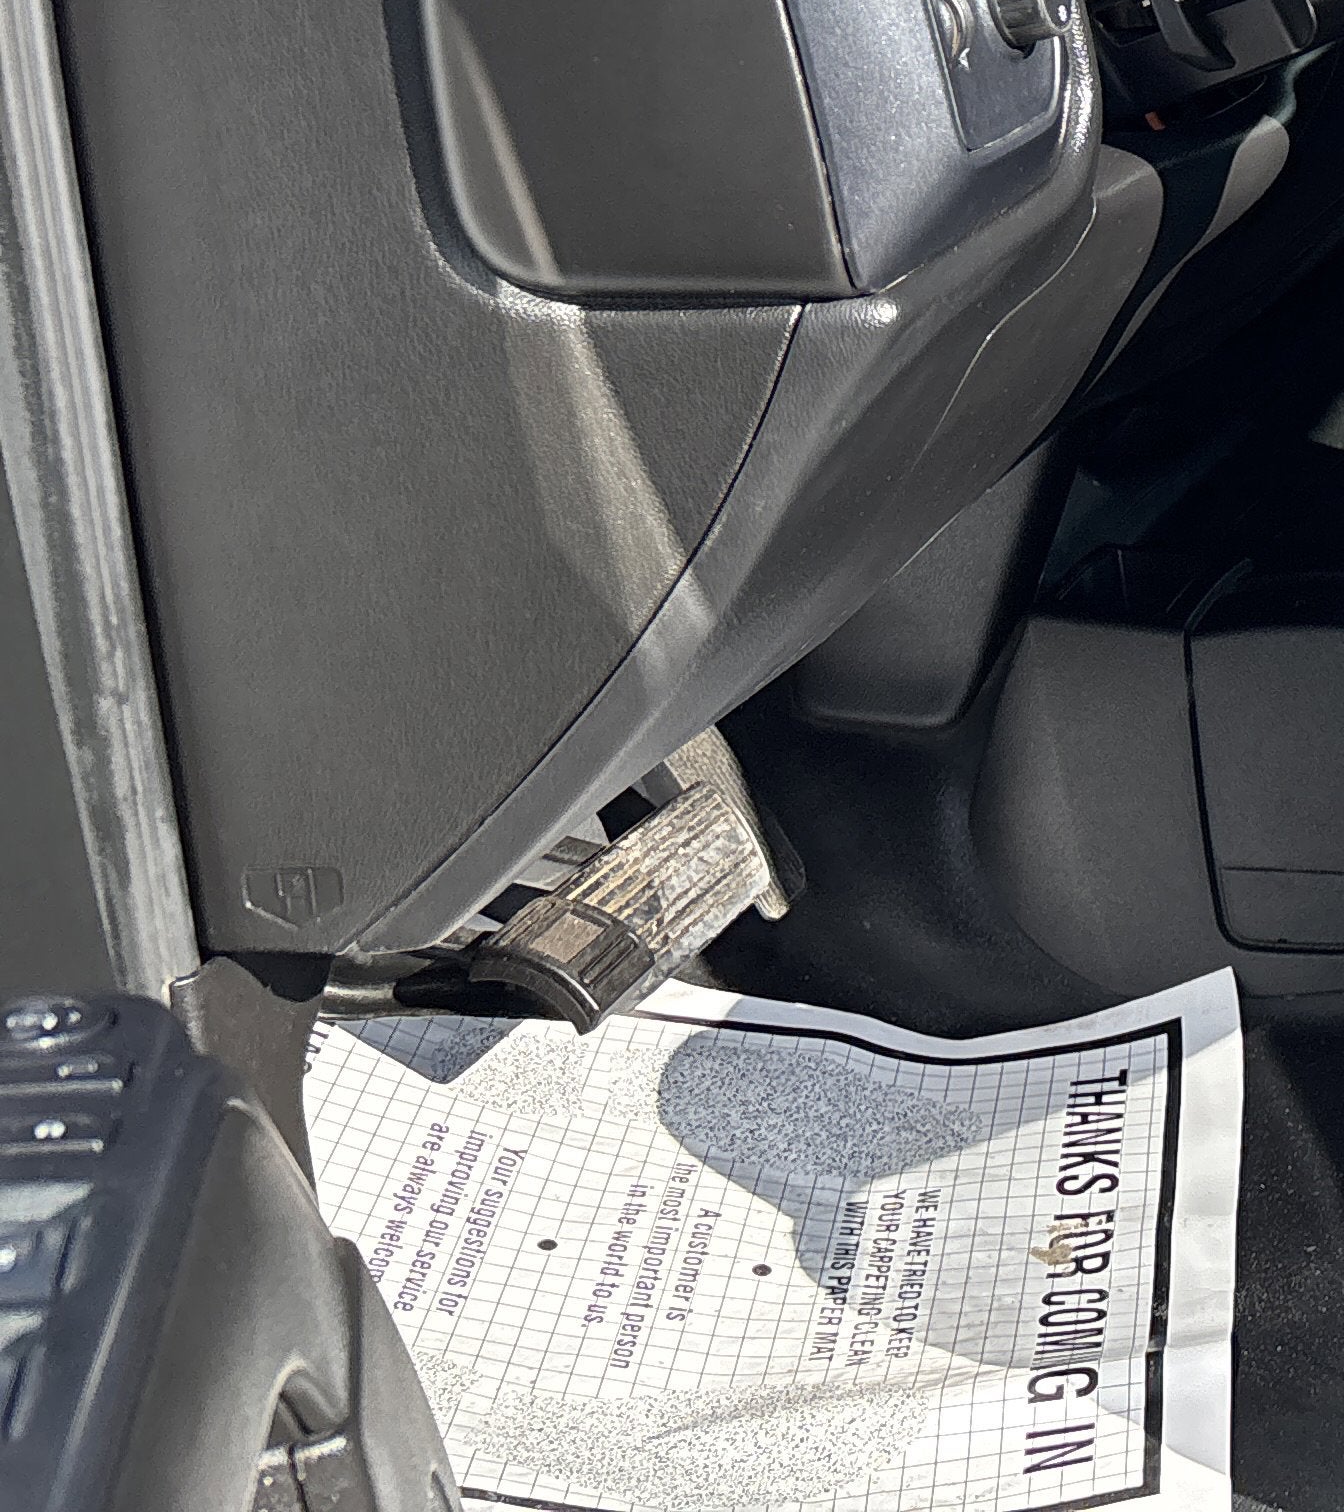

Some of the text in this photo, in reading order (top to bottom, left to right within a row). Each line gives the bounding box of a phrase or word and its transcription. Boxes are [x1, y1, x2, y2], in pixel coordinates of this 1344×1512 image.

[393, 1155, 436, 1214] always
[422, 1122, 449, 1151] are
[393, 1130, 493, 1312] improving our service
[436, 1148, 528, 1316] Your suggestions for
[581, 1184, 654, 1327] in the world to us.
[610, 1163, 698, 1369] the most important person
[666, 1208, 722, 1321] A customer is
[809, 1201, 869, 1362] WITH THIS PAPER MAT
[845, 1189, 907, 1367] YOUR CARPETING CLEAN
[885, 1189, 941, 1358] WE HAVE TRIED TO KEEP
[1023, 1069, 1128, 1474] THANKS FOR COMING IN
